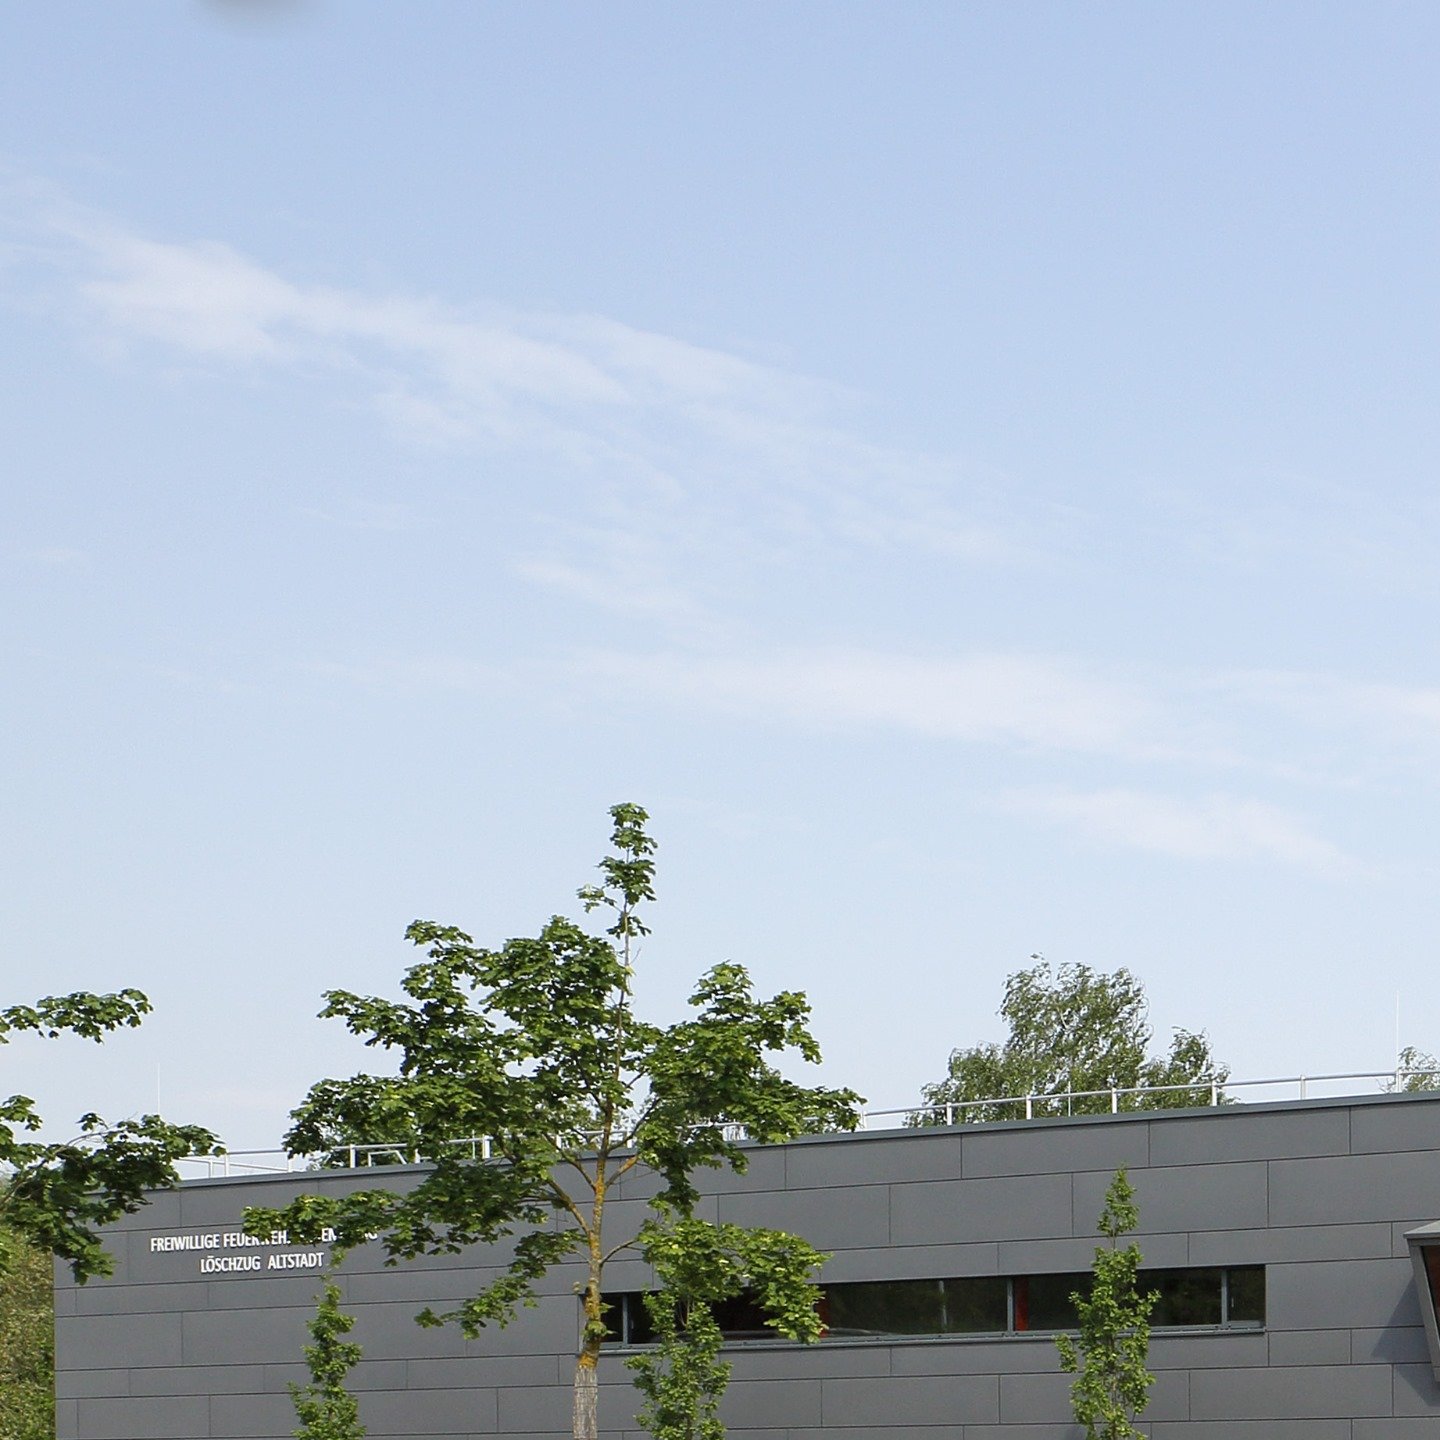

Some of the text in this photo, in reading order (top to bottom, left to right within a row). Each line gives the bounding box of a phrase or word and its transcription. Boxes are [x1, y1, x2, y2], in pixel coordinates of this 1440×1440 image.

[151, 1234, 220, 1251] FREIWILLIGE
[201, 1252, 324, 1273] LÖSCHZUG ALTSTADT
